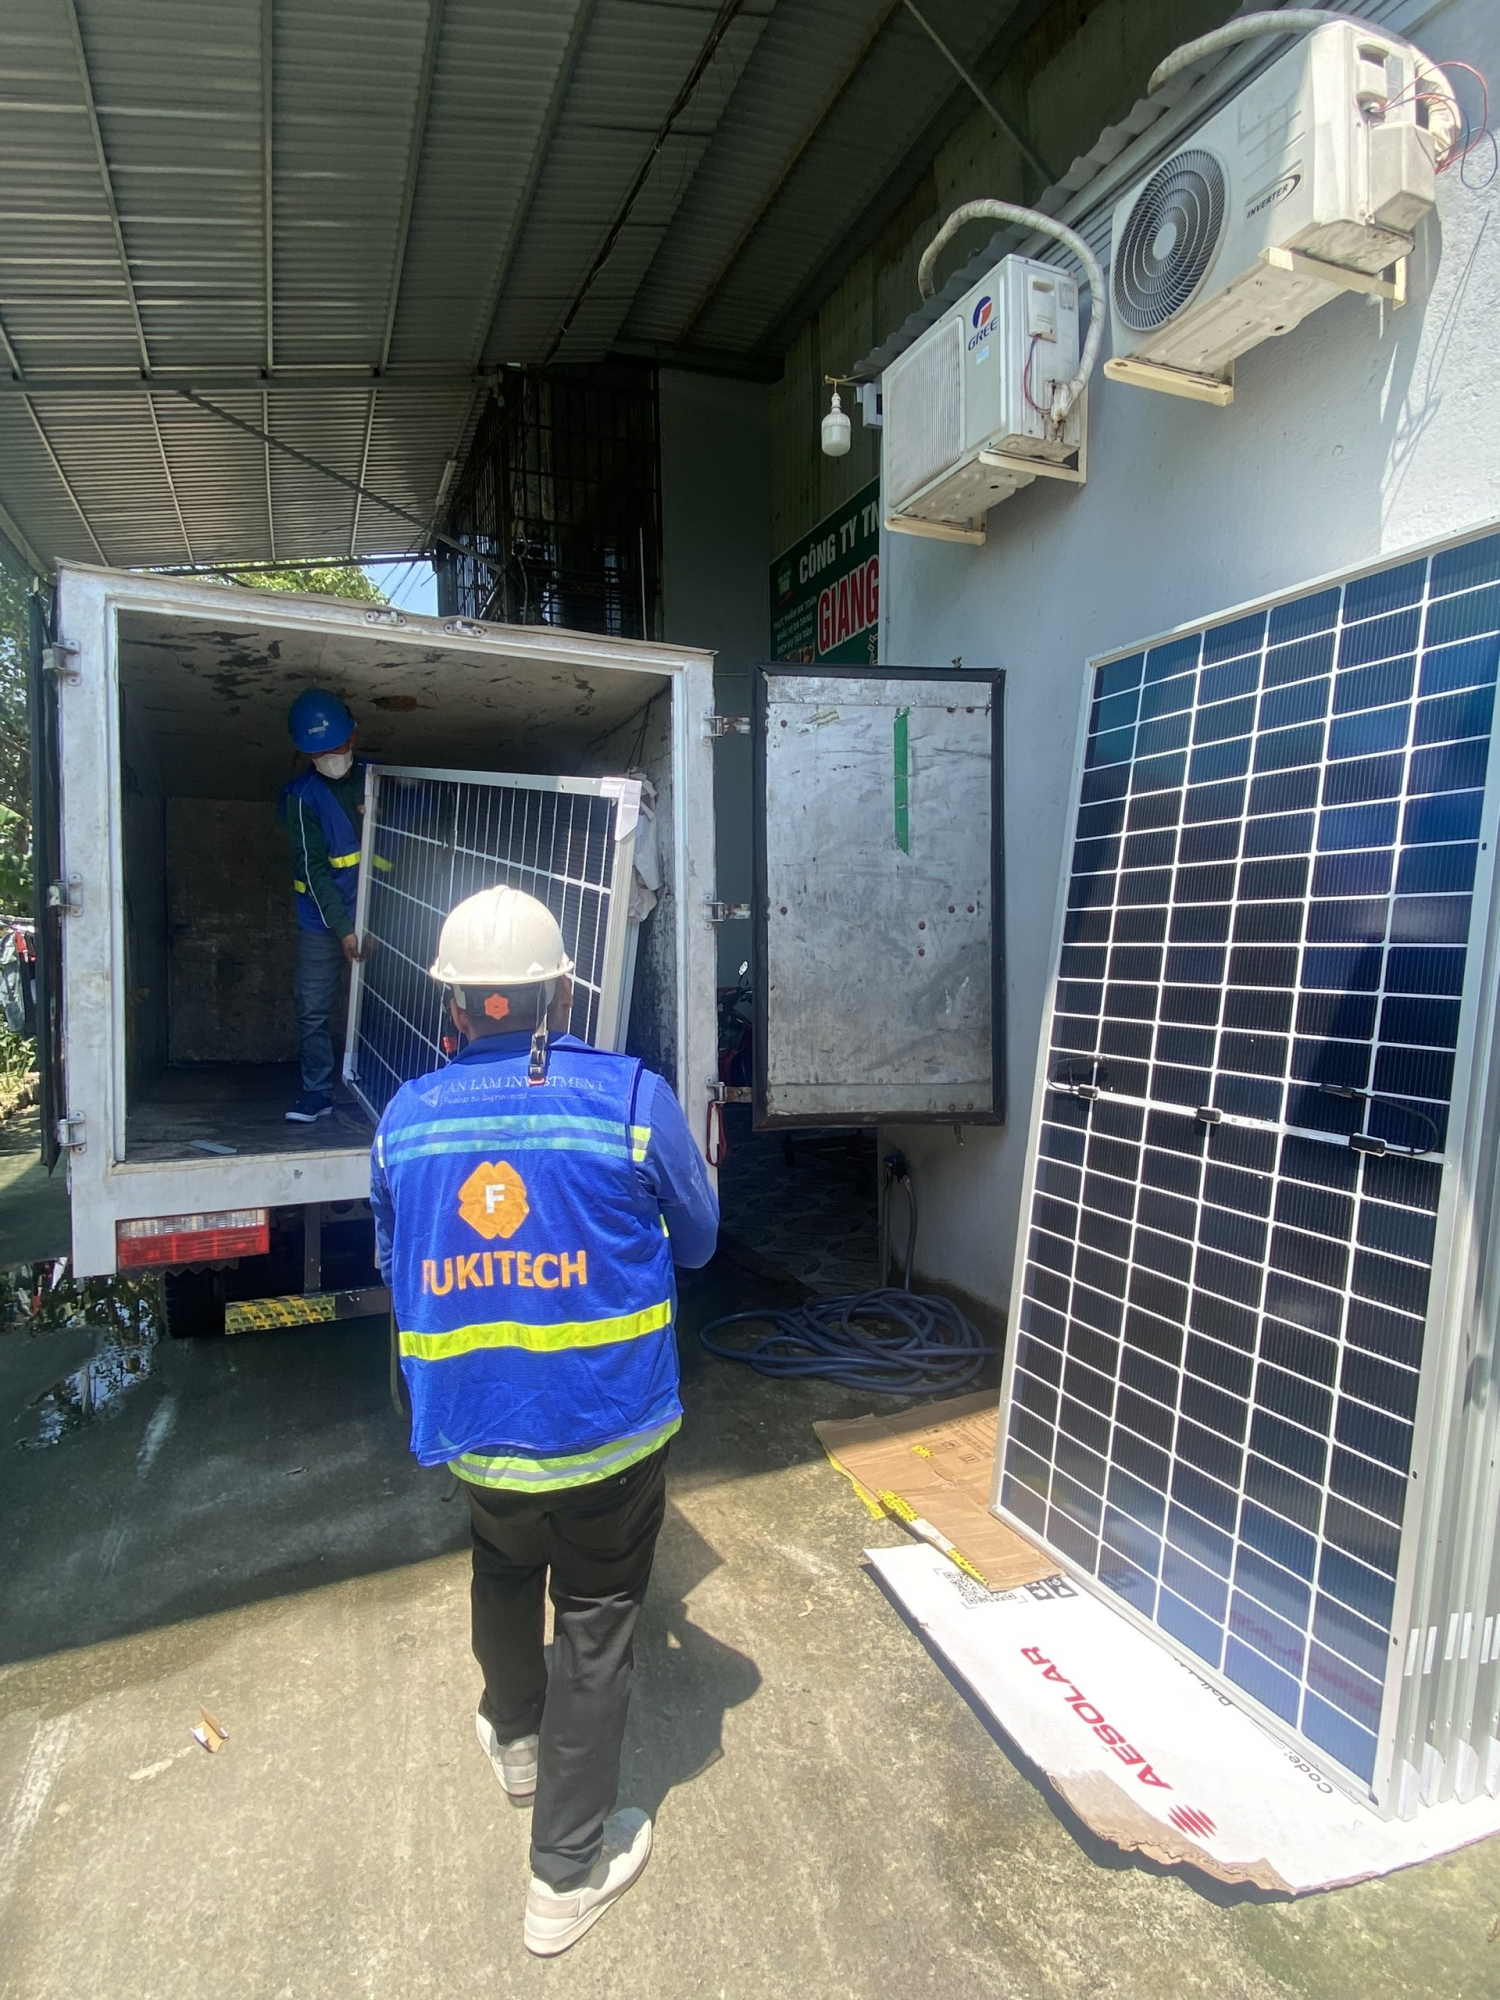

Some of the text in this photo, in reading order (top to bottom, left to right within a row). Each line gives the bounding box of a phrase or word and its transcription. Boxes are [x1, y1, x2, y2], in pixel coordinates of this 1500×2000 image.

[1246, 182, 1289, 219] INVERTER
[968, 316, 998, 351] GREE
[799, 533, 836, 585] CÔNG
[839, 514, 857, 554] TY
[818, 554, 879, 656] GIANG
[504, 1075, 606, 1092] INVSTMENT
[485, 1184, 505, 1214] F
[1020, 1646, 1174, 1790] AESOLAR
[1283, 1751, 1333, 1795] Code:
